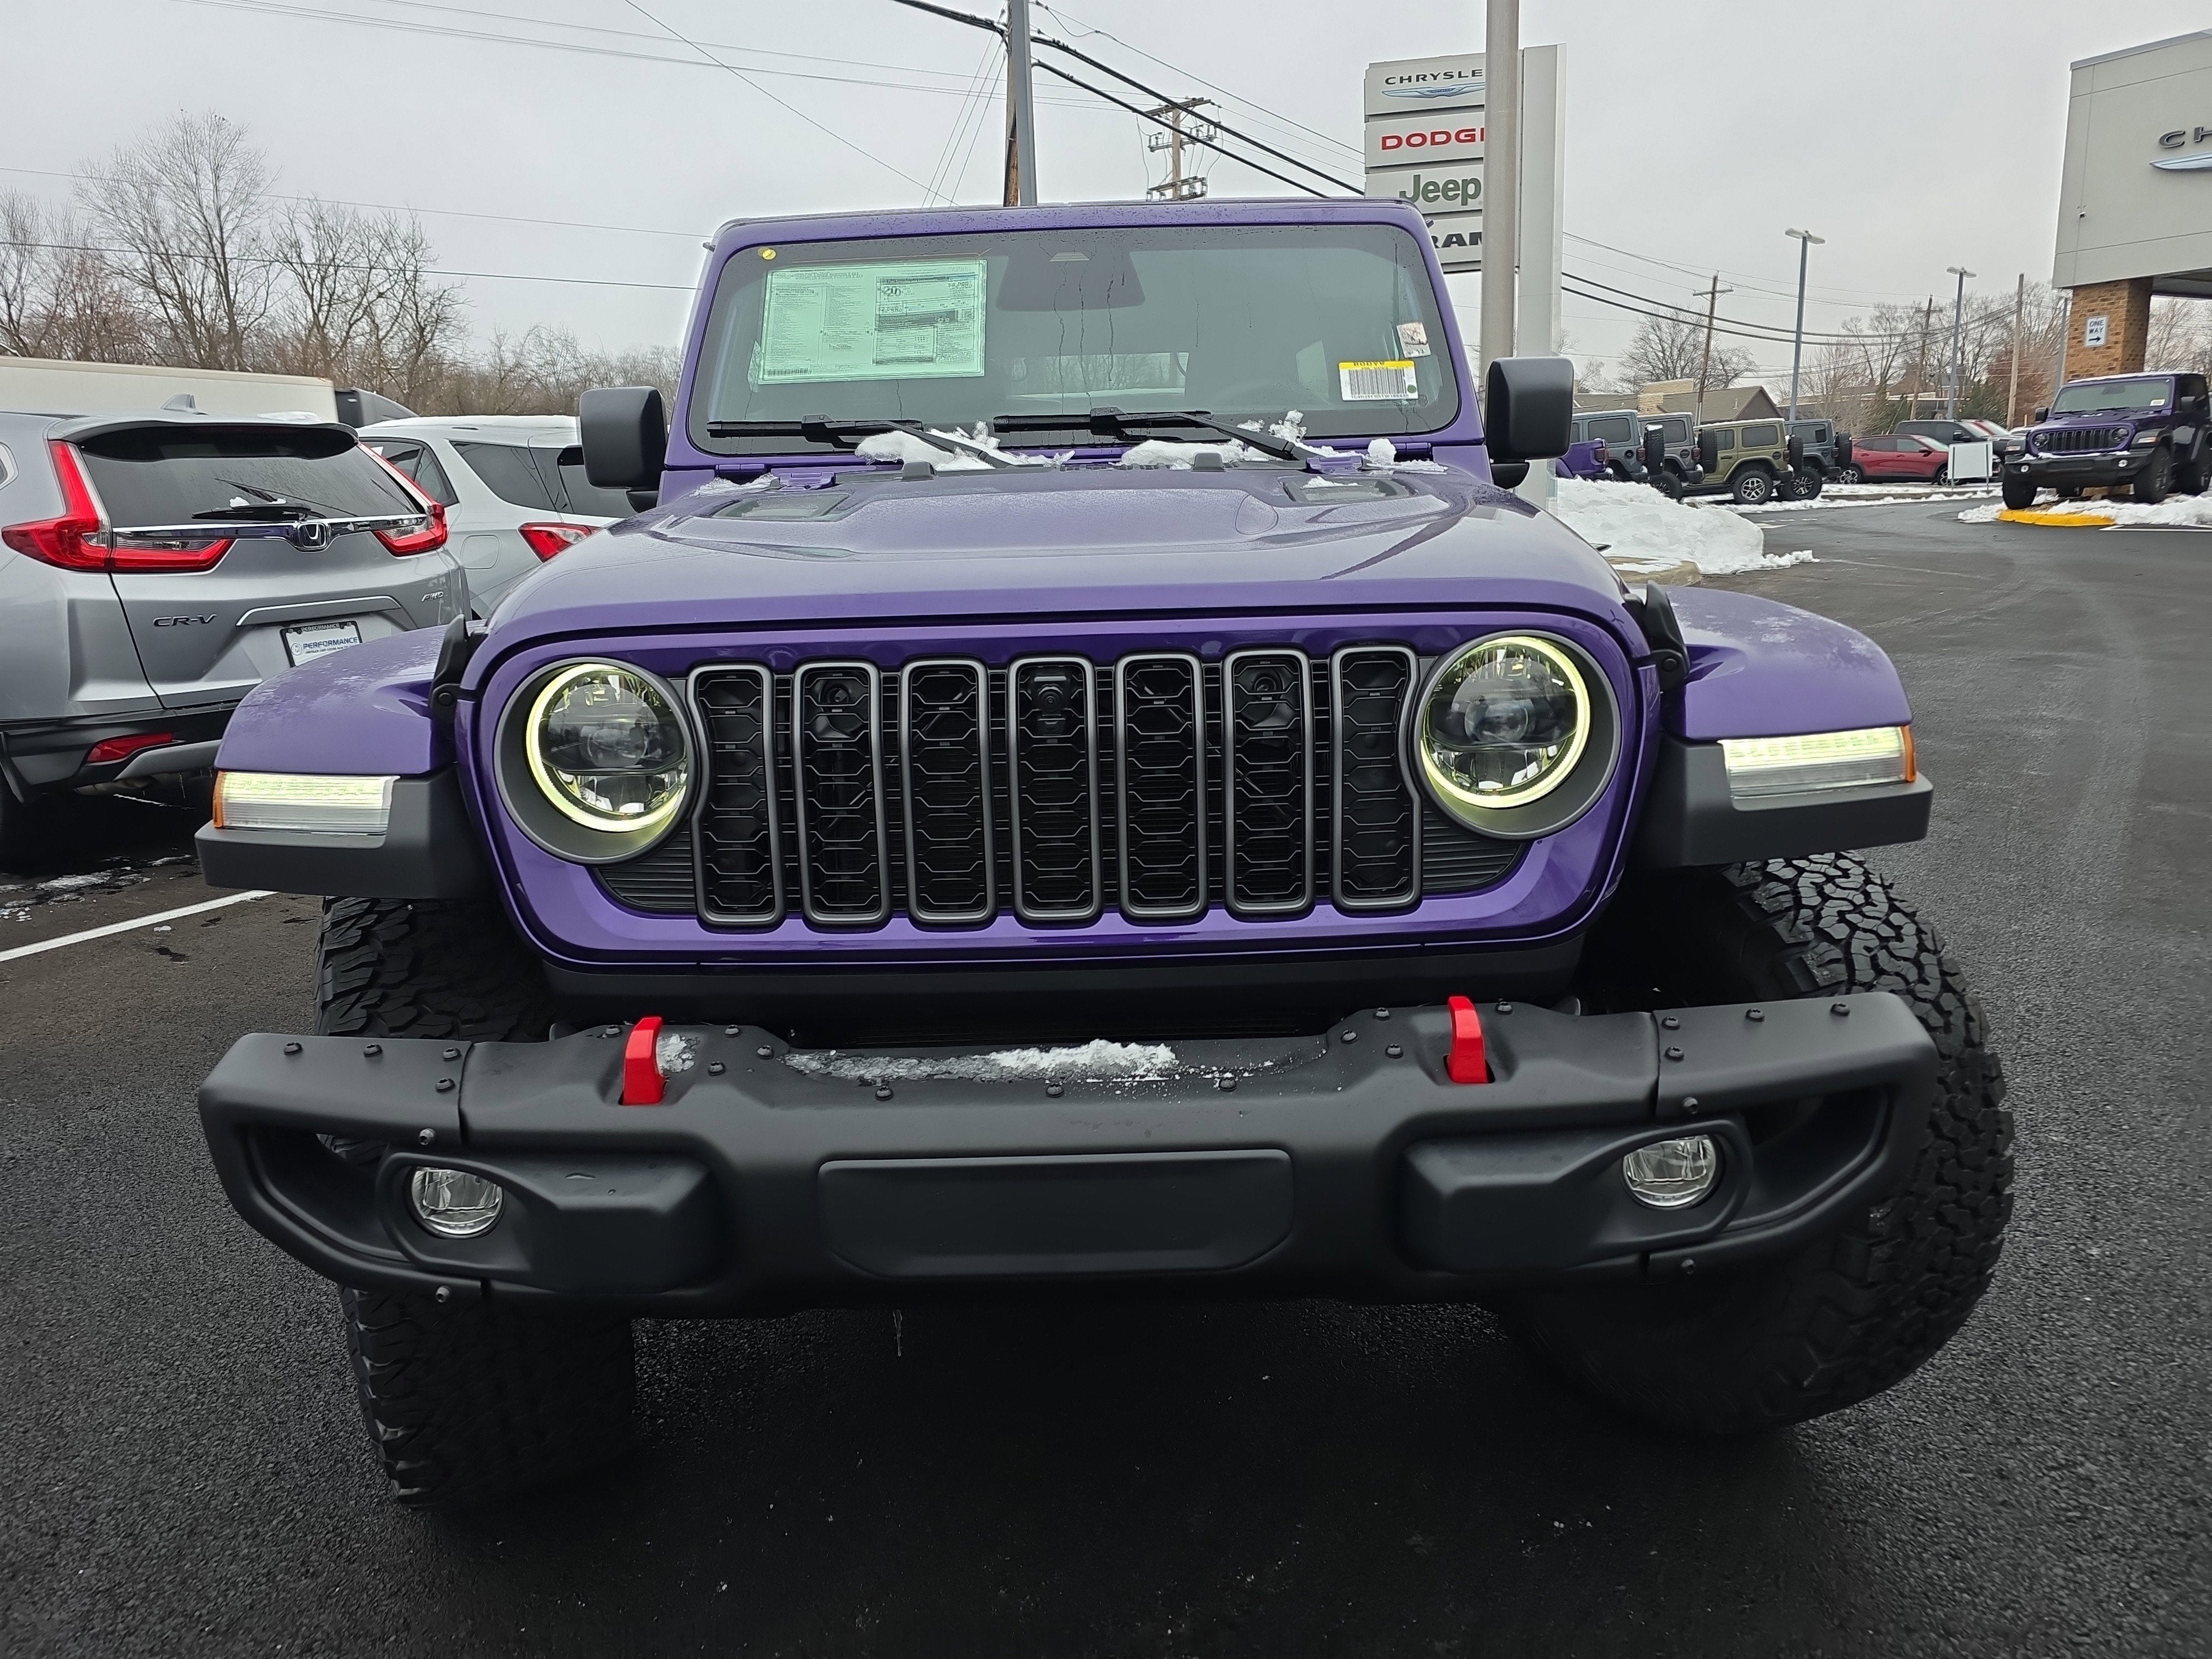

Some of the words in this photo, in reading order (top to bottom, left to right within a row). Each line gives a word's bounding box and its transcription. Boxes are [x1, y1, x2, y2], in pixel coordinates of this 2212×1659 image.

[1385, 69, 1483, 85] CHRYSLE
[1399, 174, 1481, 206] Jeep
[2089, 319, 2105, 327] ONE
[153, 614, 217, 627] CR-V
[301, 623, 340, 632] PERFORMANCE
[303, 636, 358, 650] PERFORMANCE
